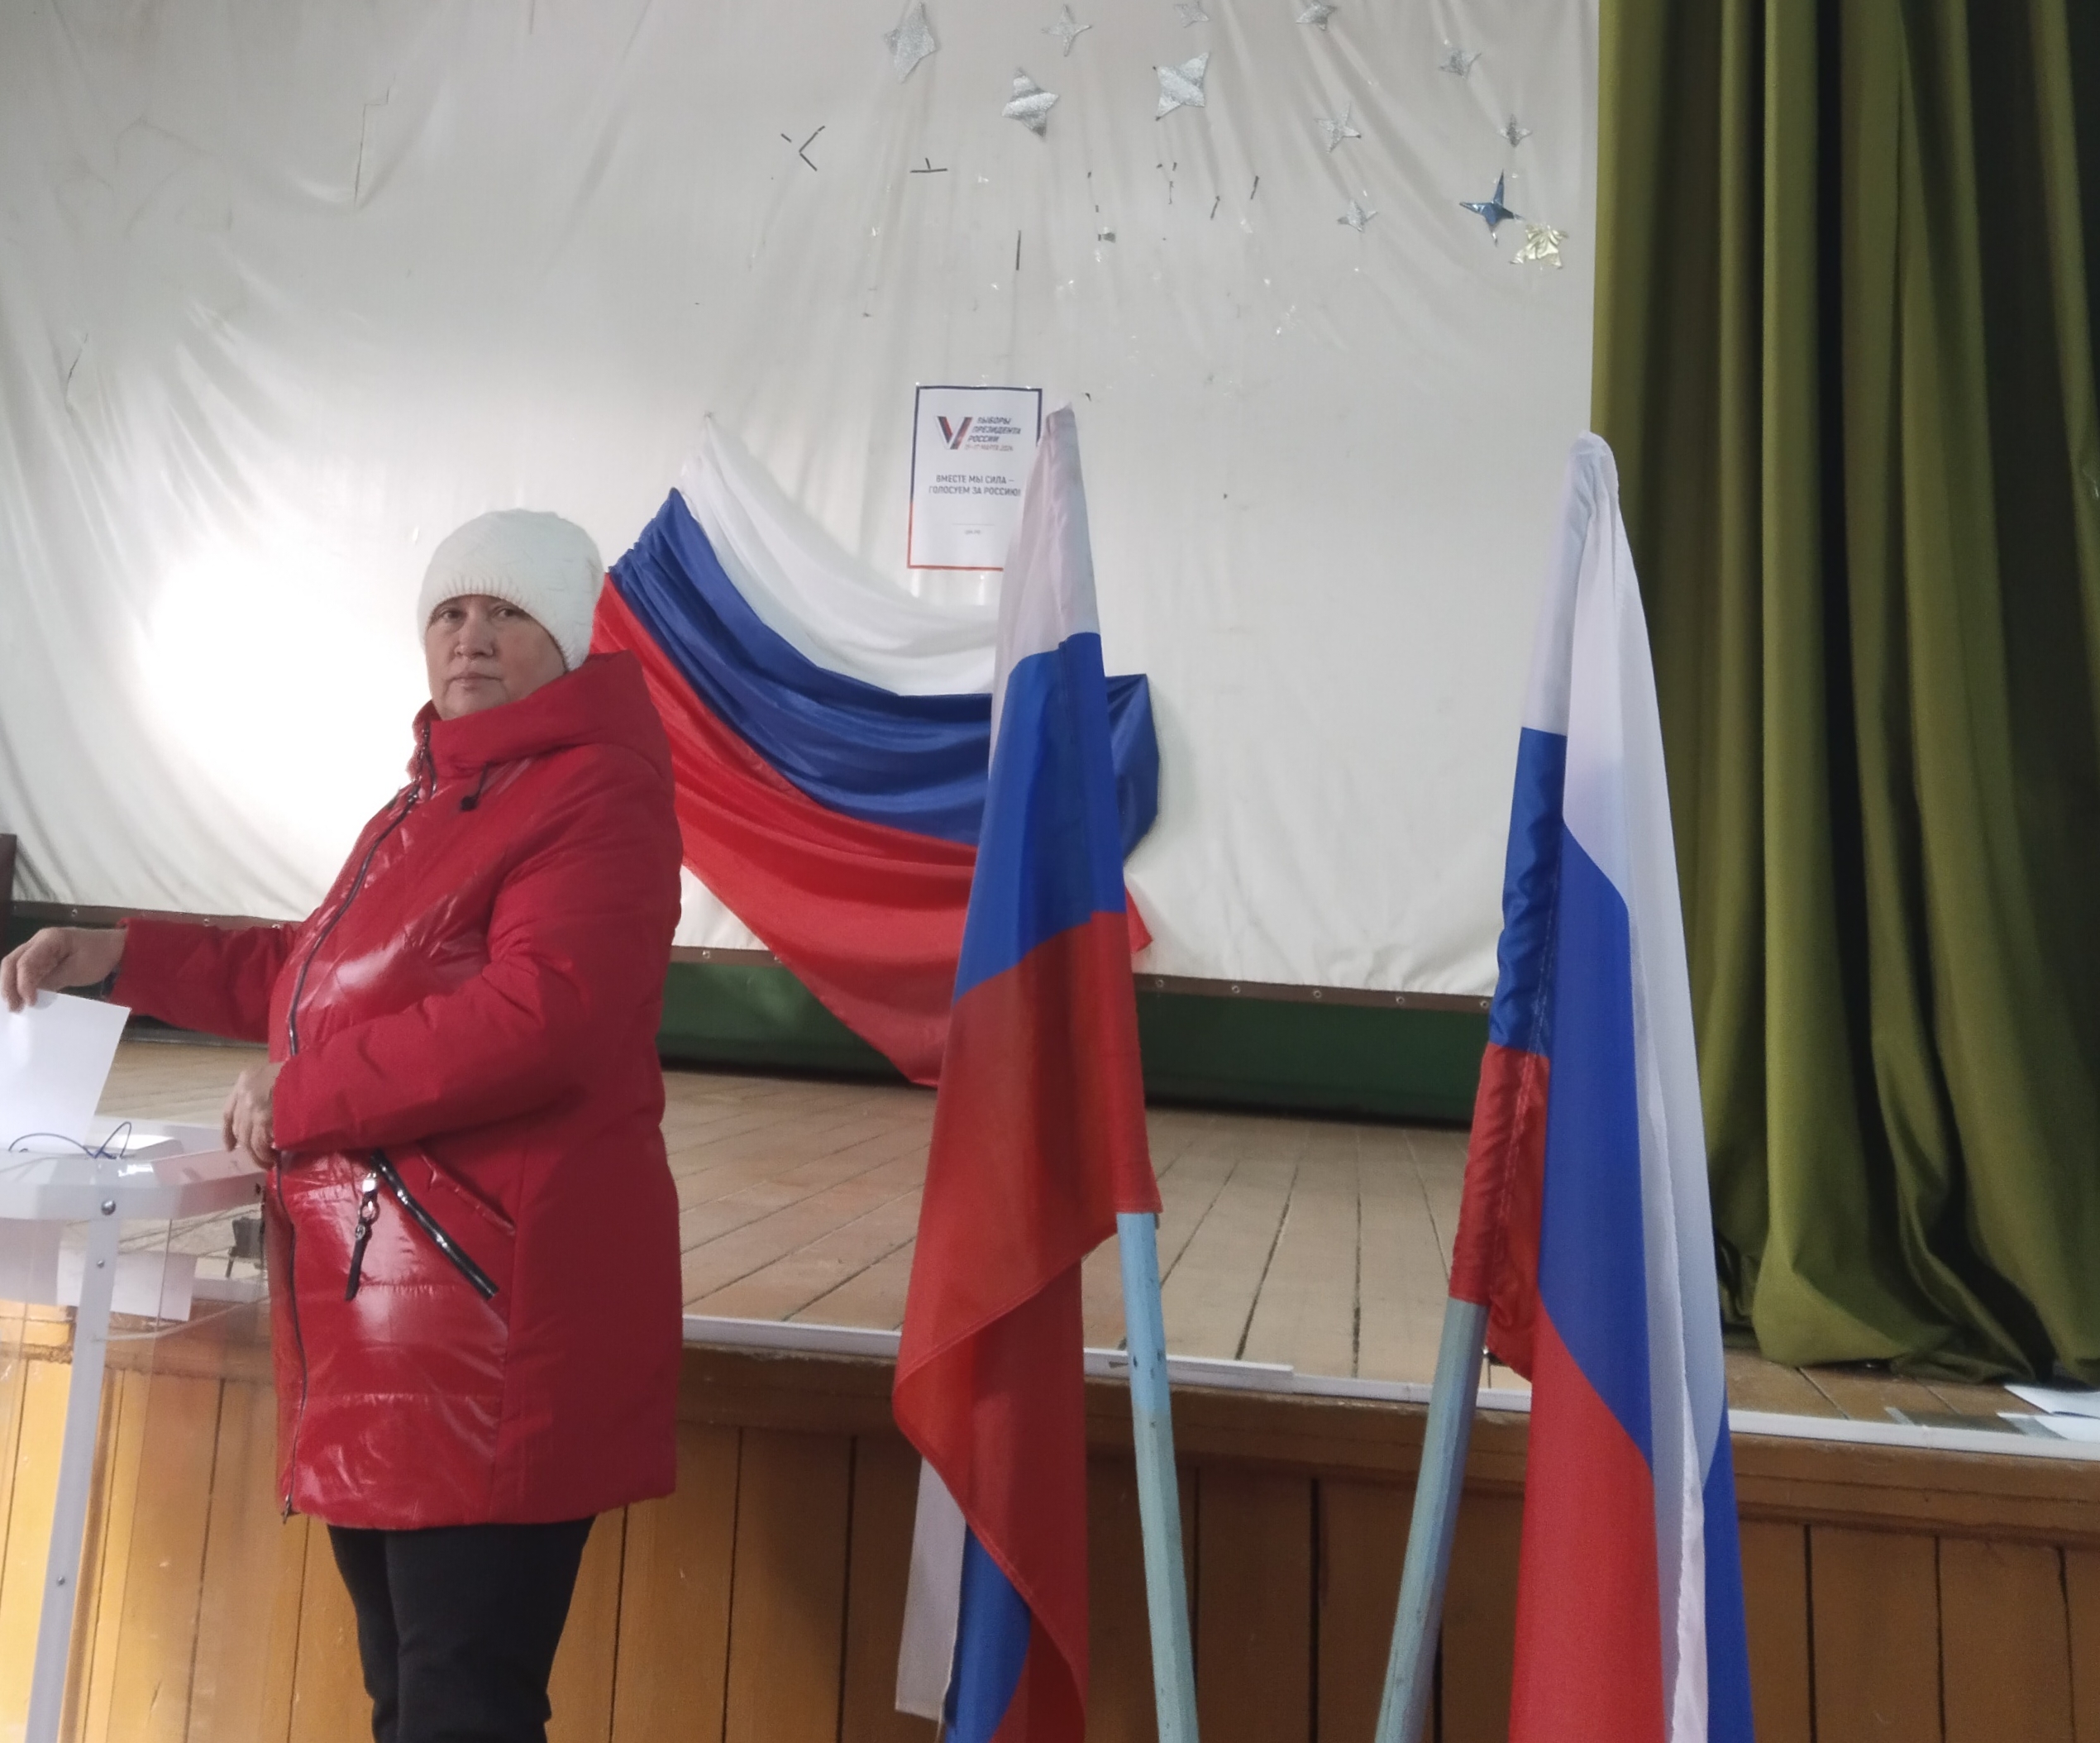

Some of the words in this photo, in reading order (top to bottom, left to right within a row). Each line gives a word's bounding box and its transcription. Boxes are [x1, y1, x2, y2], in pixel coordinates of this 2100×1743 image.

[977, 417, 1011, 425] ВЫБОРЫ
[972, 426, 1021, 435] ПРЕЗИДЕНТА
[936, 475, 966, 483] ВМЕСТЕ
[968, 475, 984, 484] МЫ
[985, 475, 1007, 484] СИЛА
[928, 485, 970, 494] ГОЛОСУЕМ
[971, 486, 982, 494] ЗА
[983, 487, 1021, 496] РОССИЮ!
